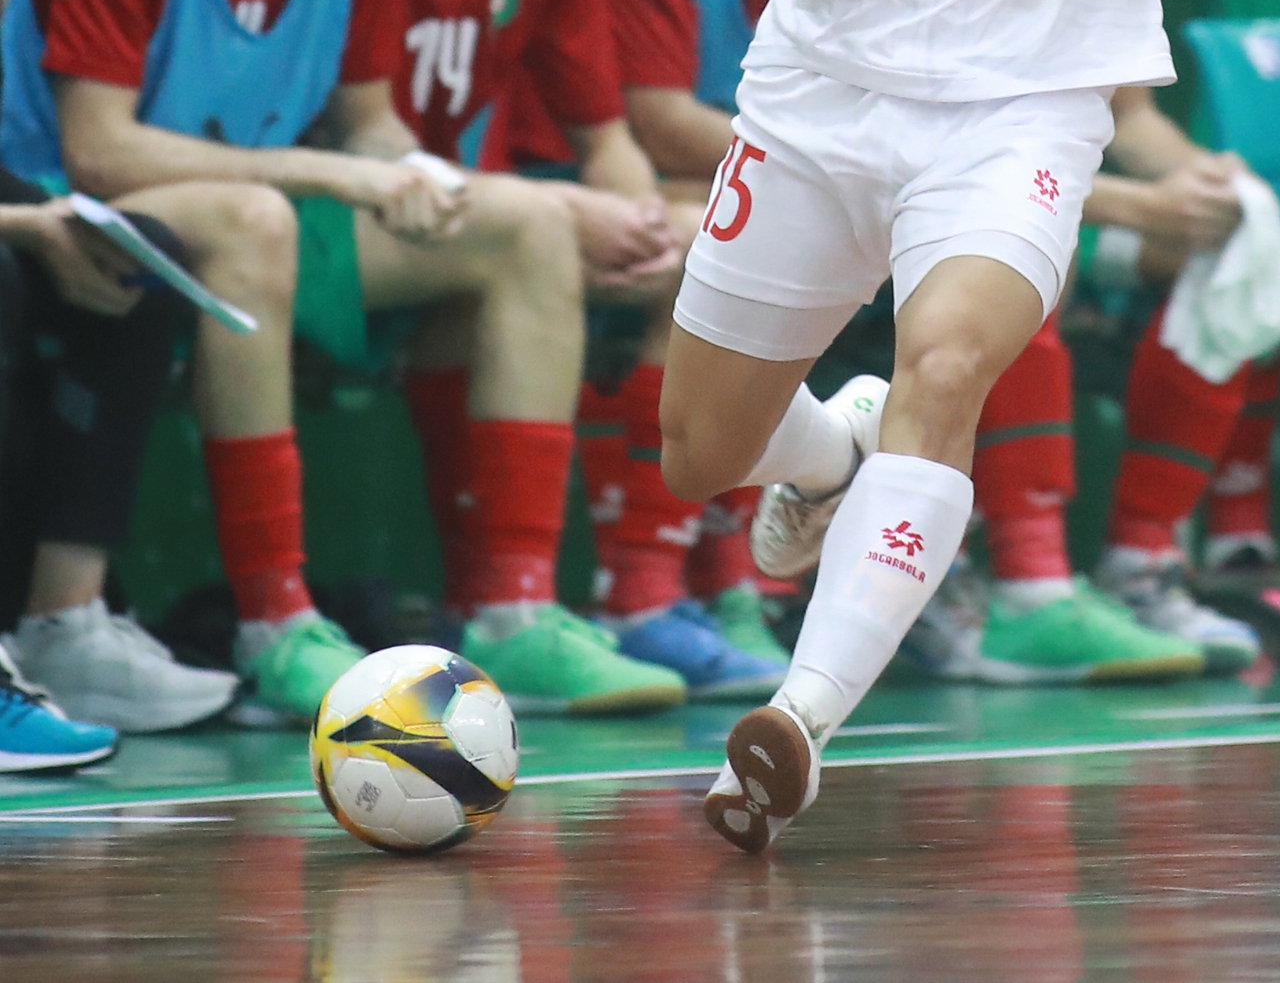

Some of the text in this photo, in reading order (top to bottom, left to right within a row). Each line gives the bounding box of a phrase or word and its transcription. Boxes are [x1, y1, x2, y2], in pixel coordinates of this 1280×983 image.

[405, 17, 479, 115] 14
[703, 135, 767, 242] 15
[865, 551, 926, 583] JOGARBOLA
